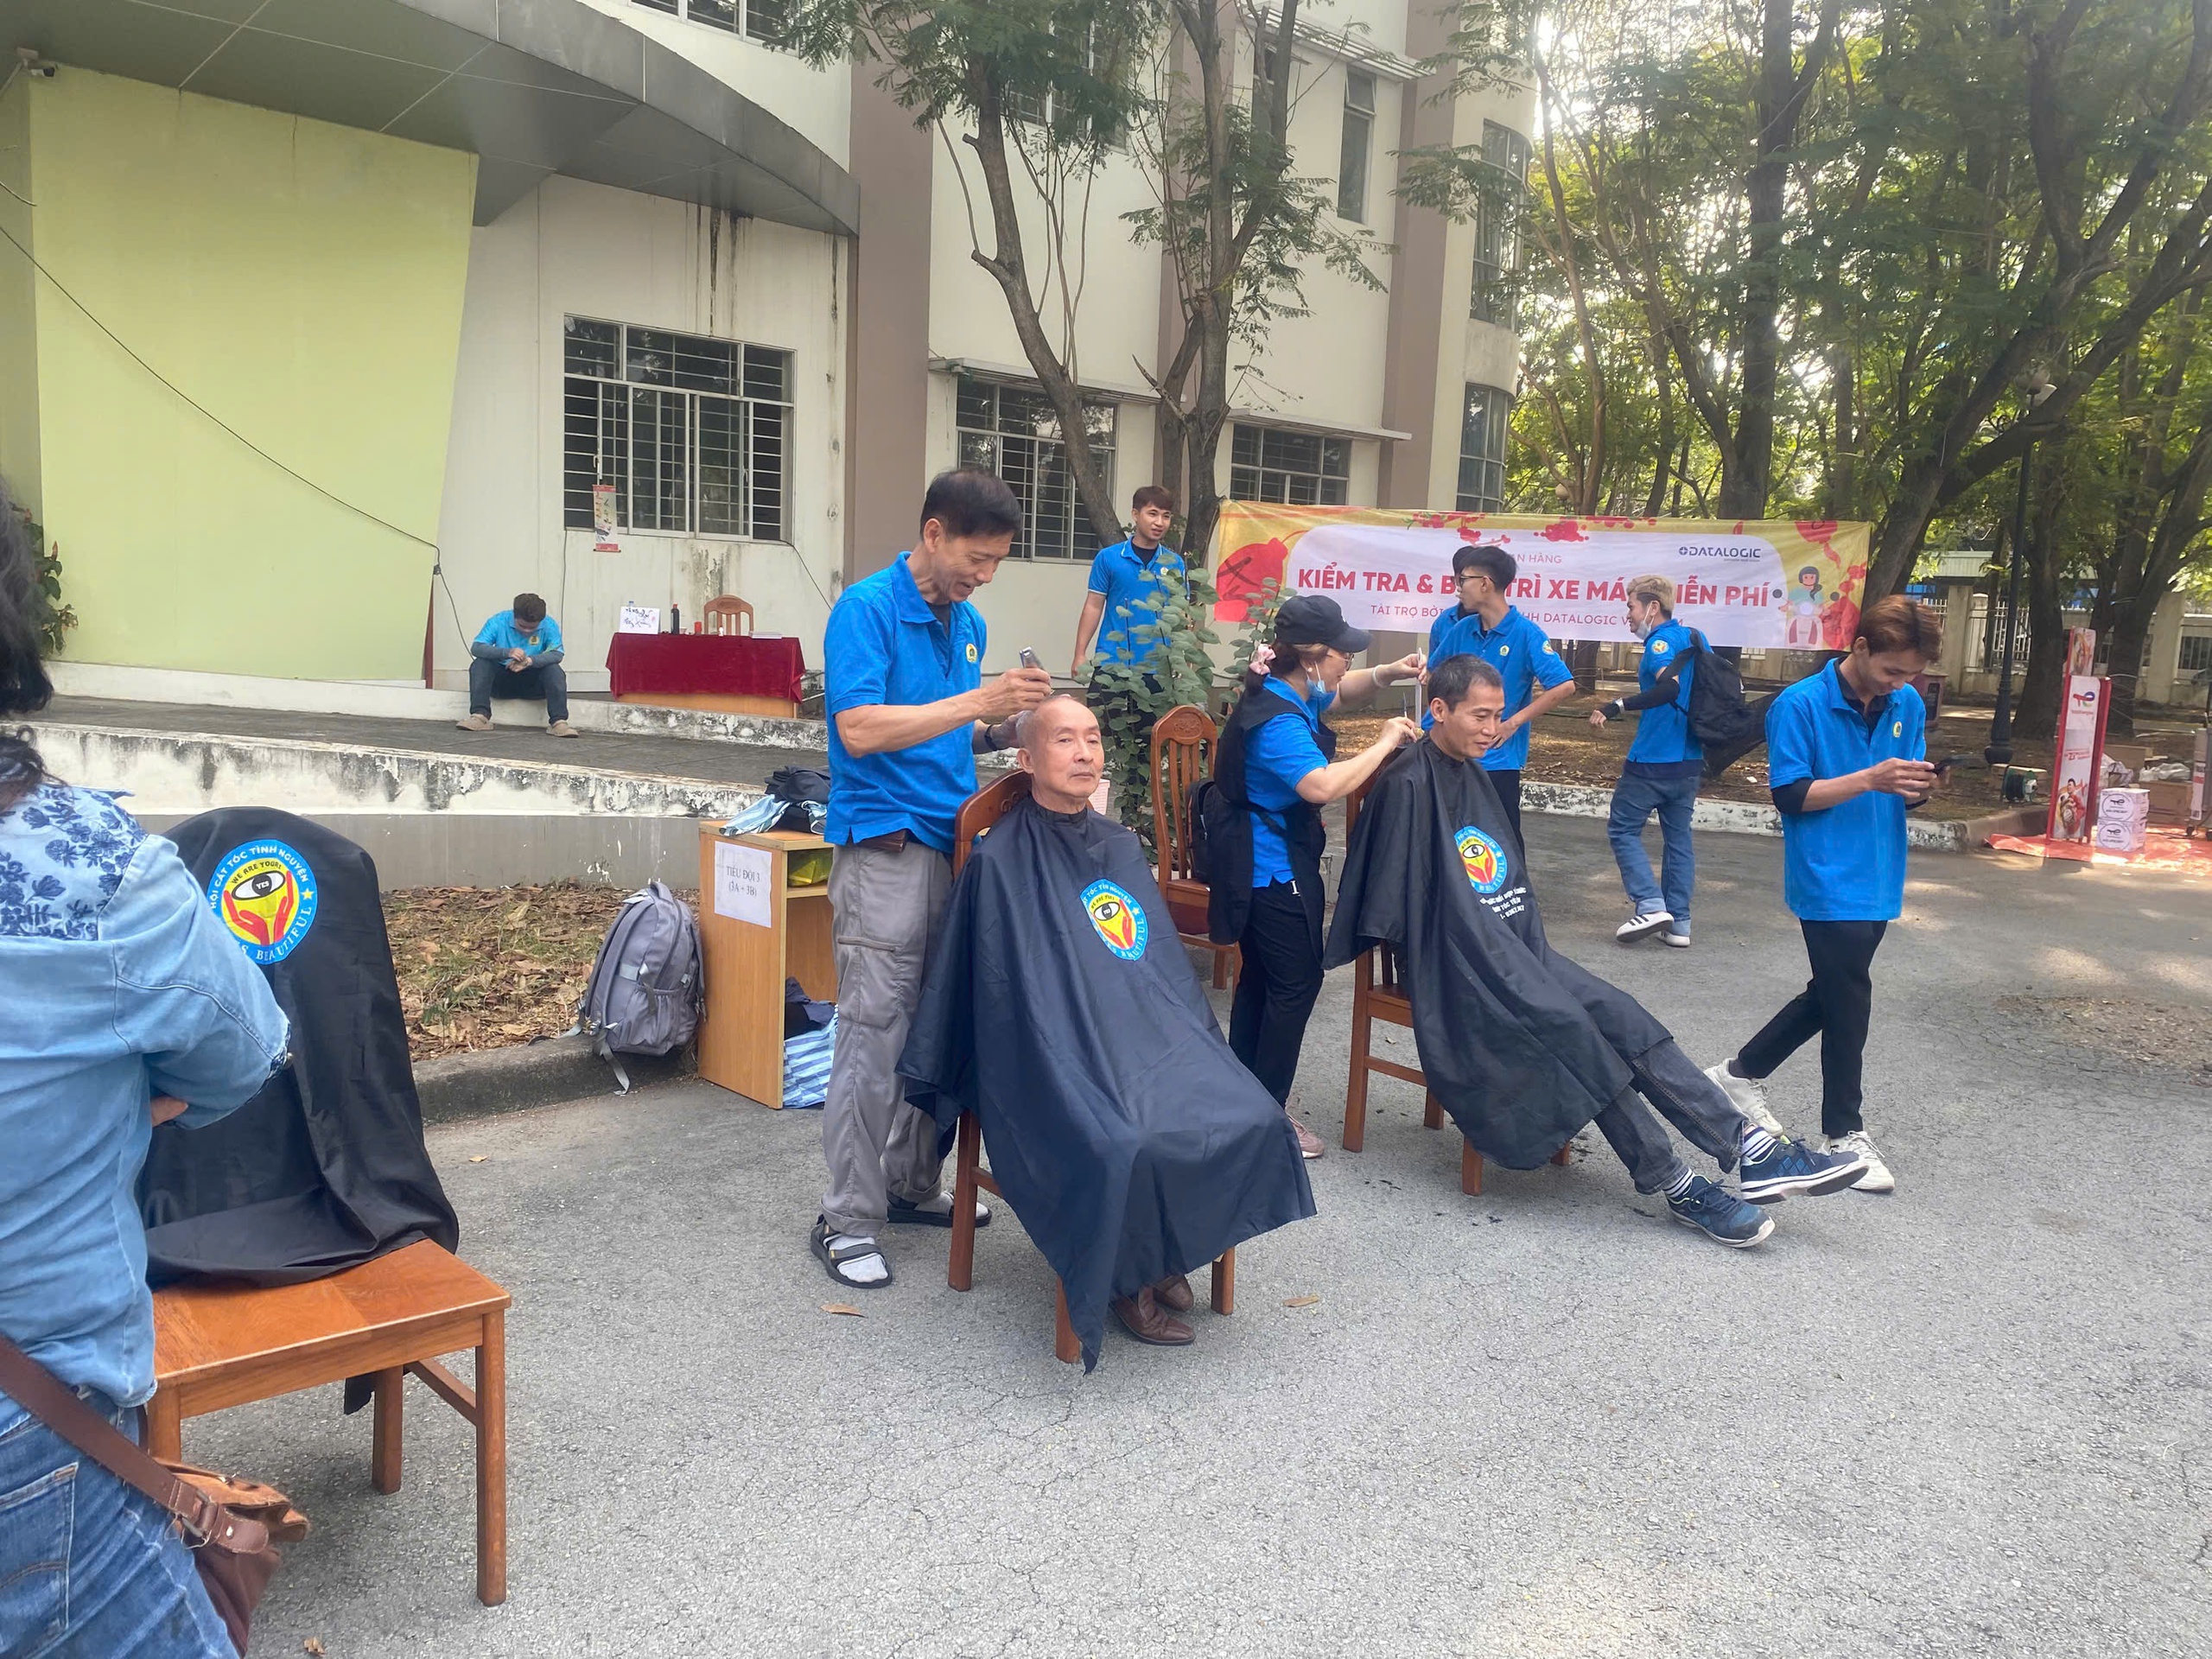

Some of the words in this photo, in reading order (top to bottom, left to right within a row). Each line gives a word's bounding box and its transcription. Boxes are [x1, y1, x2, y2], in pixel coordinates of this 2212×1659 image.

[1529, 552, 1562, 563] HÀNG
[1688, 546, 1762, 558] DATALOGIC
[1298, 562, 1357, 590] KIỂM
[1363, 571, 1410, 593] TRA
[1416, 575, 1433, 594] &
[1505, 573, 1541, 599] TRÌ
[1547, 578, 1580, 601] XE
[1586, 576, 1628, 601] MÁ
[1675, 575, 1718, 605] IỄN
[1725, 582, 1771, 607] PHÍ
[1394, 607, 1418, 619] TRỢ
[1543, 613, 1618, 626] DATALOGIC
[227, 850, 248, 868] TÓC
[250, 845, 277, 855] TÌNH
[277, 849, 309, 883] NGUYỆN
[232, 873, 243, 884] WE
[244, 863, 258, 875] ARE
[255, 880, 270, 889] YES
[256, 906, 312, 961] BEAUTIFUL
